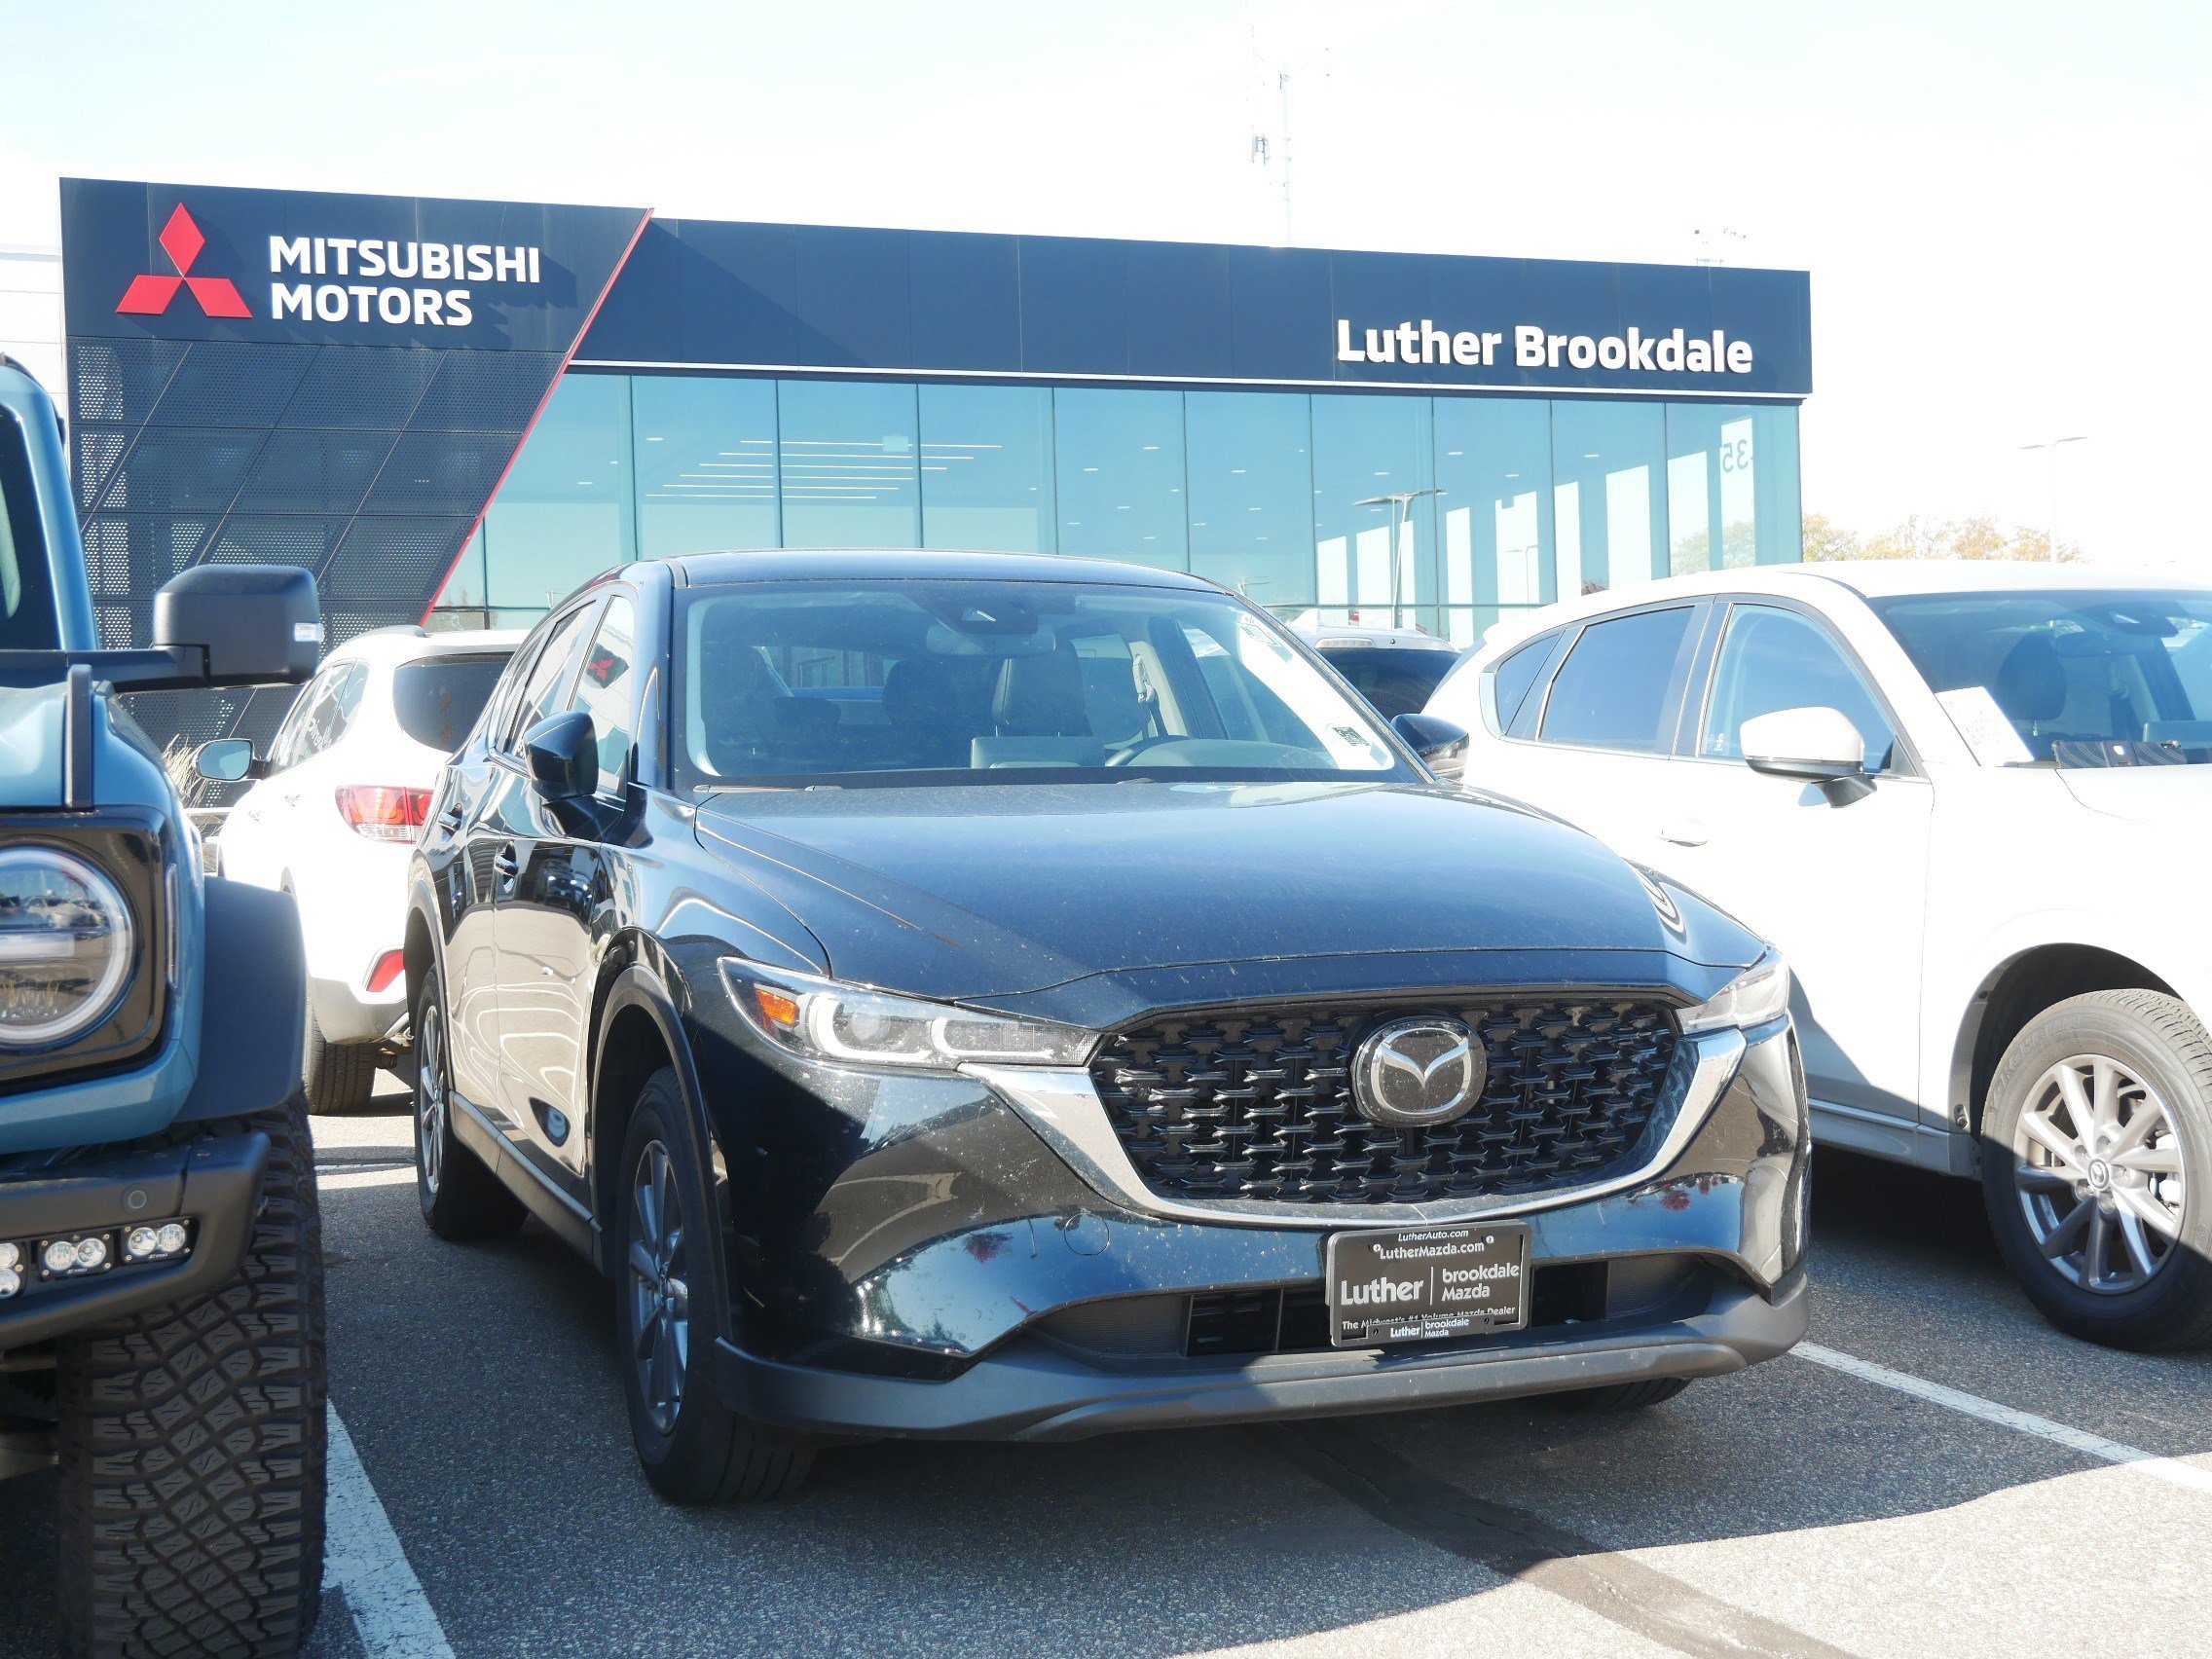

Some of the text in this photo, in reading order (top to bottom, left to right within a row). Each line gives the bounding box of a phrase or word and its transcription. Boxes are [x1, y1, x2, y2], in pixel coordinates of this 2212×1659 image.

[270, 235, 540, 283] MITSUBISHI
[272, 283, 473, 327] MOTORS
[1337, 319, 1752, 373] Luther Brookdale
[1398, 1230, 1469, 1242] LutherAuto.com
[1380, 1242, 1485, 1260] LutherMazda.com
[1442, 1263, 1520, 1283] brookdale
[1341, 1277, 1424, 1306] Luther
[1441, 1283, 1491, 1302] Mazda
[1342, 1319, 1359, 1330] The
[1487, 1307, 1516, 1315] Dealer
[1424, 1318, 1470, 1329] brookdale
[1390, 1326, 1421, 1338] Luther
[1424, 1329, 1450, 1338] Mazda
